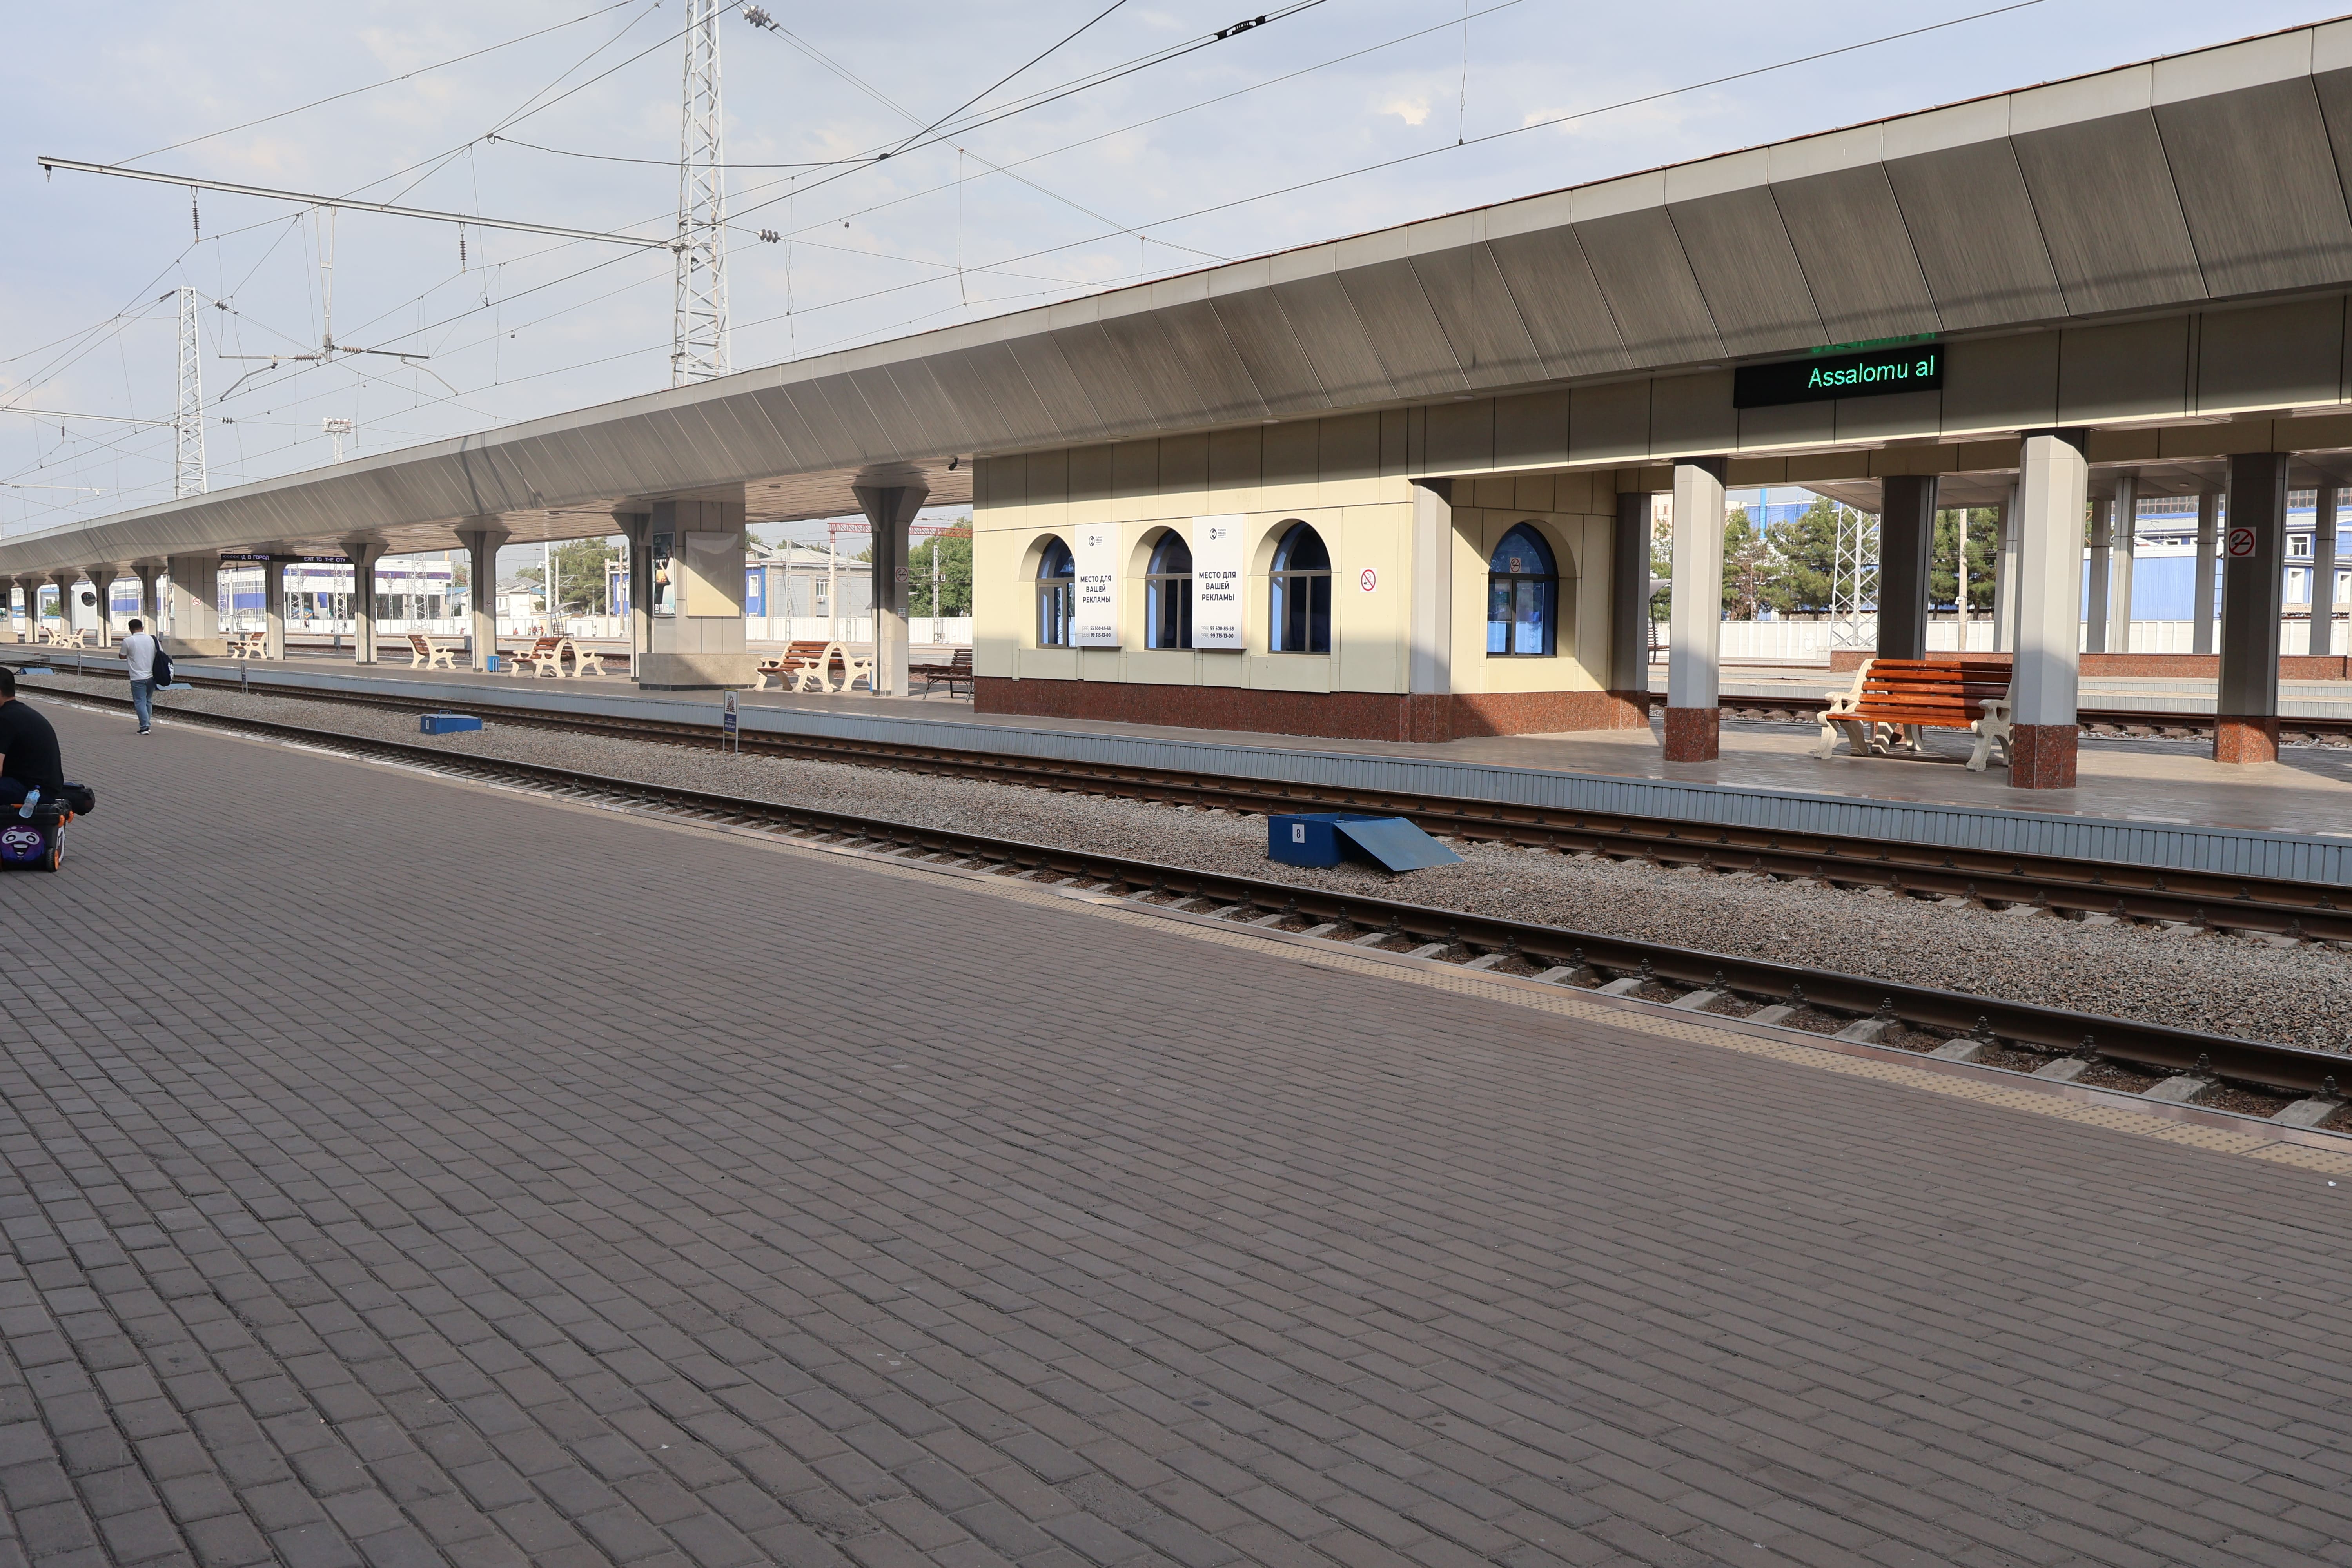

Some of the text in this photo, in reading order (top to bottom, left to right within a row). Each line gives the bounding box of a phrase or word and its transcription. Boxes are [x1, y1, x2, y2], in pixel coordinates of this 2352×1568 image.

[1808, 355, 1934, 388] Assalomu al
[1222, 571, 1236, 579] ДЛЯ
[1086, 584, 1106, 593] ВАШЕЙ
[1206, 581, 1229, 590] ВАШЕЙ
[1297, 829, 1301, 838] 8
